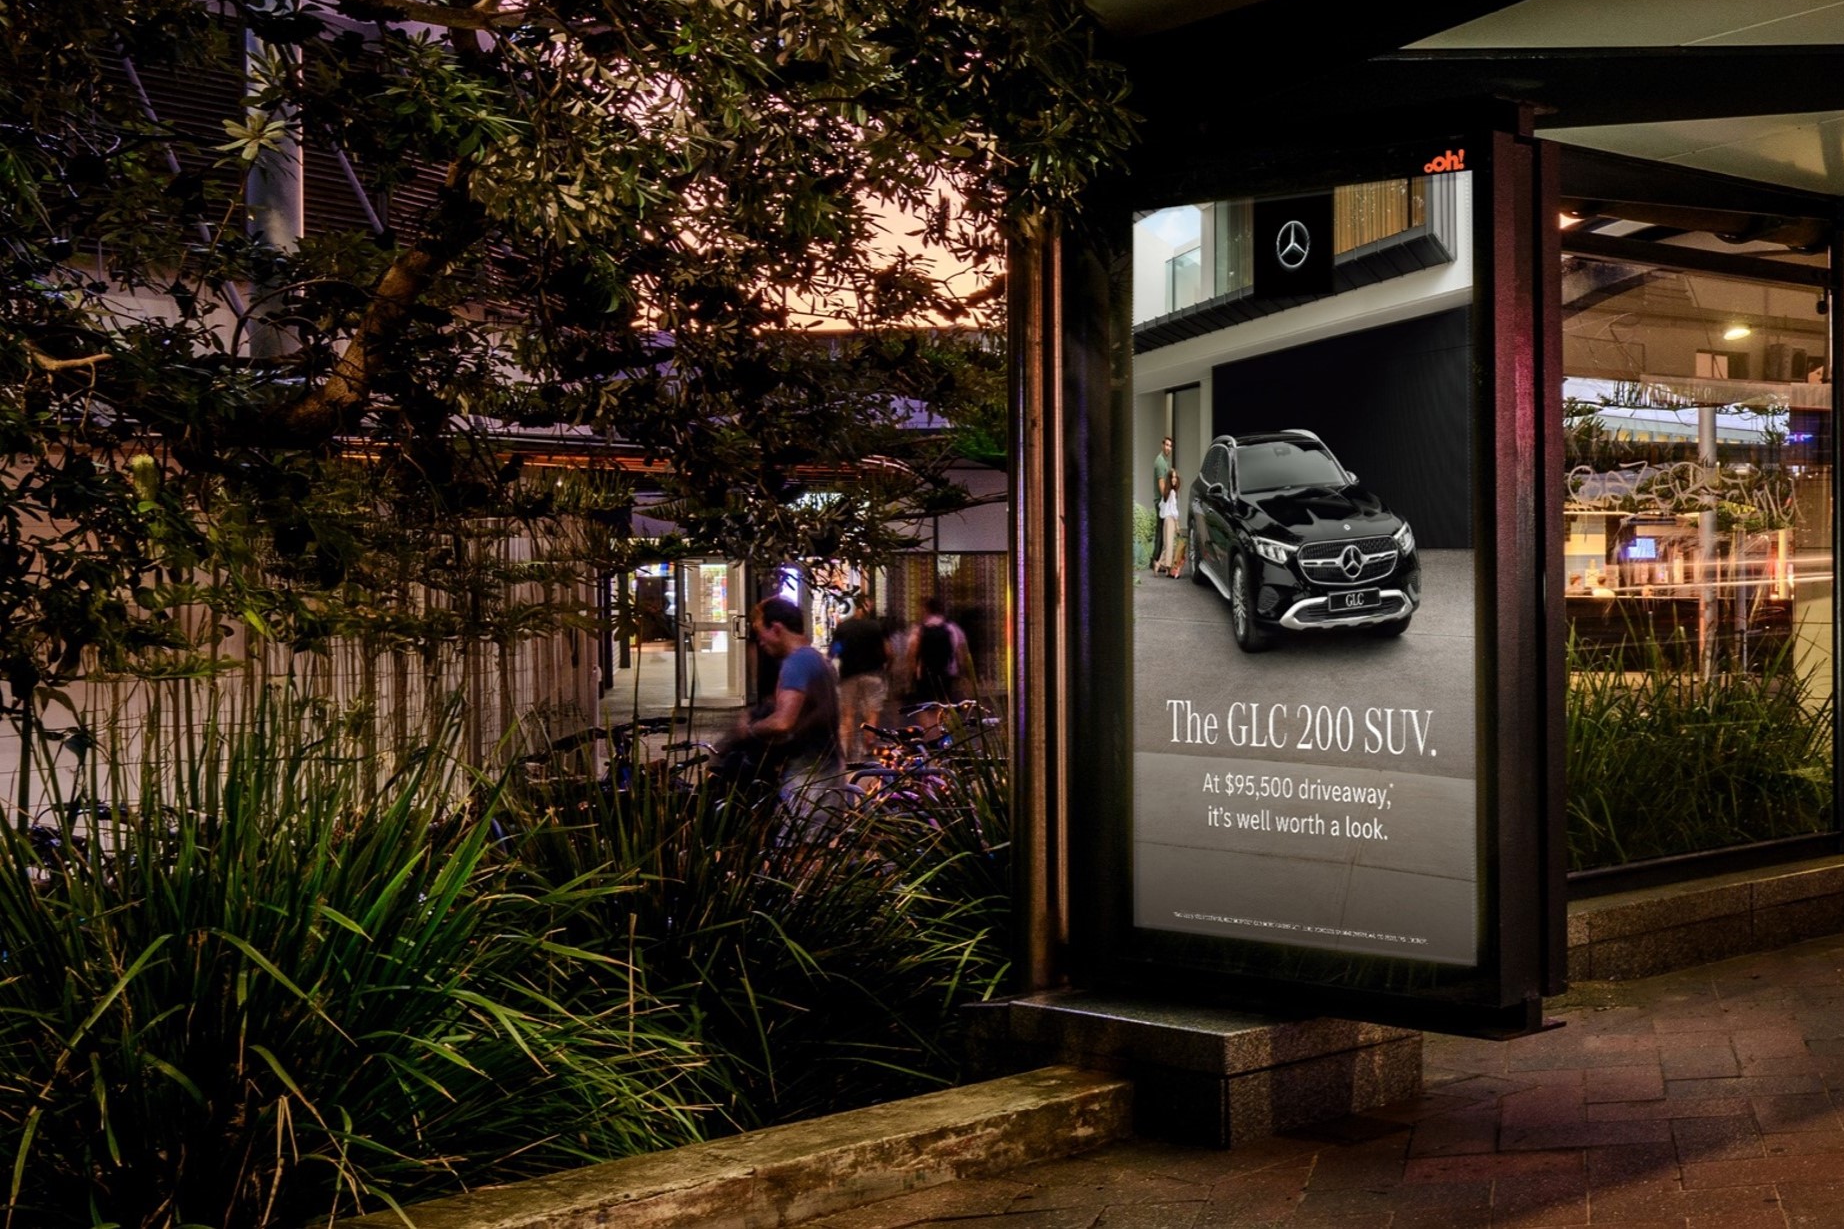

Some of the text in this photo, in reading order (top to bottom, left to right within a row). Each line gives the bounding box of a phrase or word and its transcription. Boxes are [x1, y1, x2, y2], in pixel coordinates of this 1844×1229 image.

[1345, 592, 1365, 608] GLC
[1166, 699, 1437, 757] The GLC 200 SUV.
[1202, 772, 1220, 794] At
[1225, 772, 1293, 801] $95,500
[1208, 805, 1388, 840] it's well worth a look.
